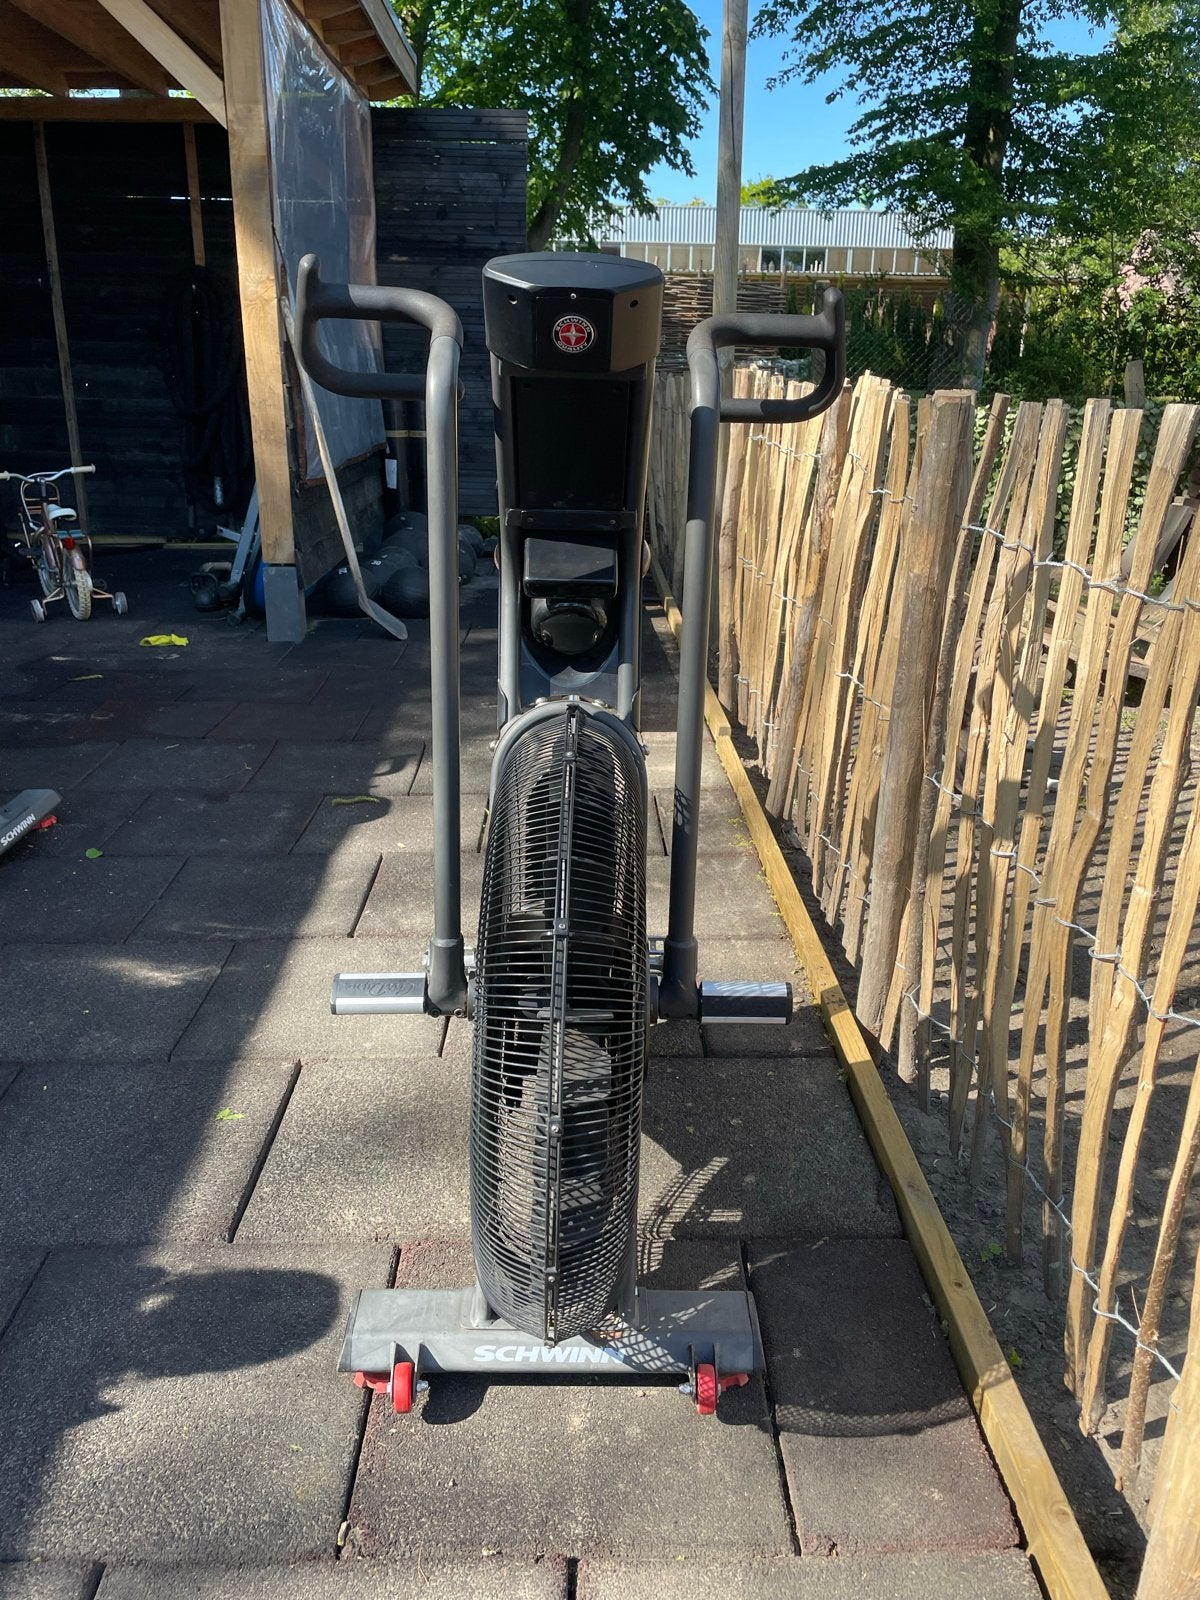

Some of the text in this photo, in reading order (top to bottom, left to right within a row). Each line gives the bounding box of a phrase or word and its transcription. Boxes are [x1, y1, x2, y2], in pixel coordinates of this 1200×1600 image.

[555, 318, 591, 333] SCHWINN
[557, 341, 587, 351] QUALITY
[0, 814, 36, 846] SCHWINN
[472, 1344, 625, 1363] SCHWINN
